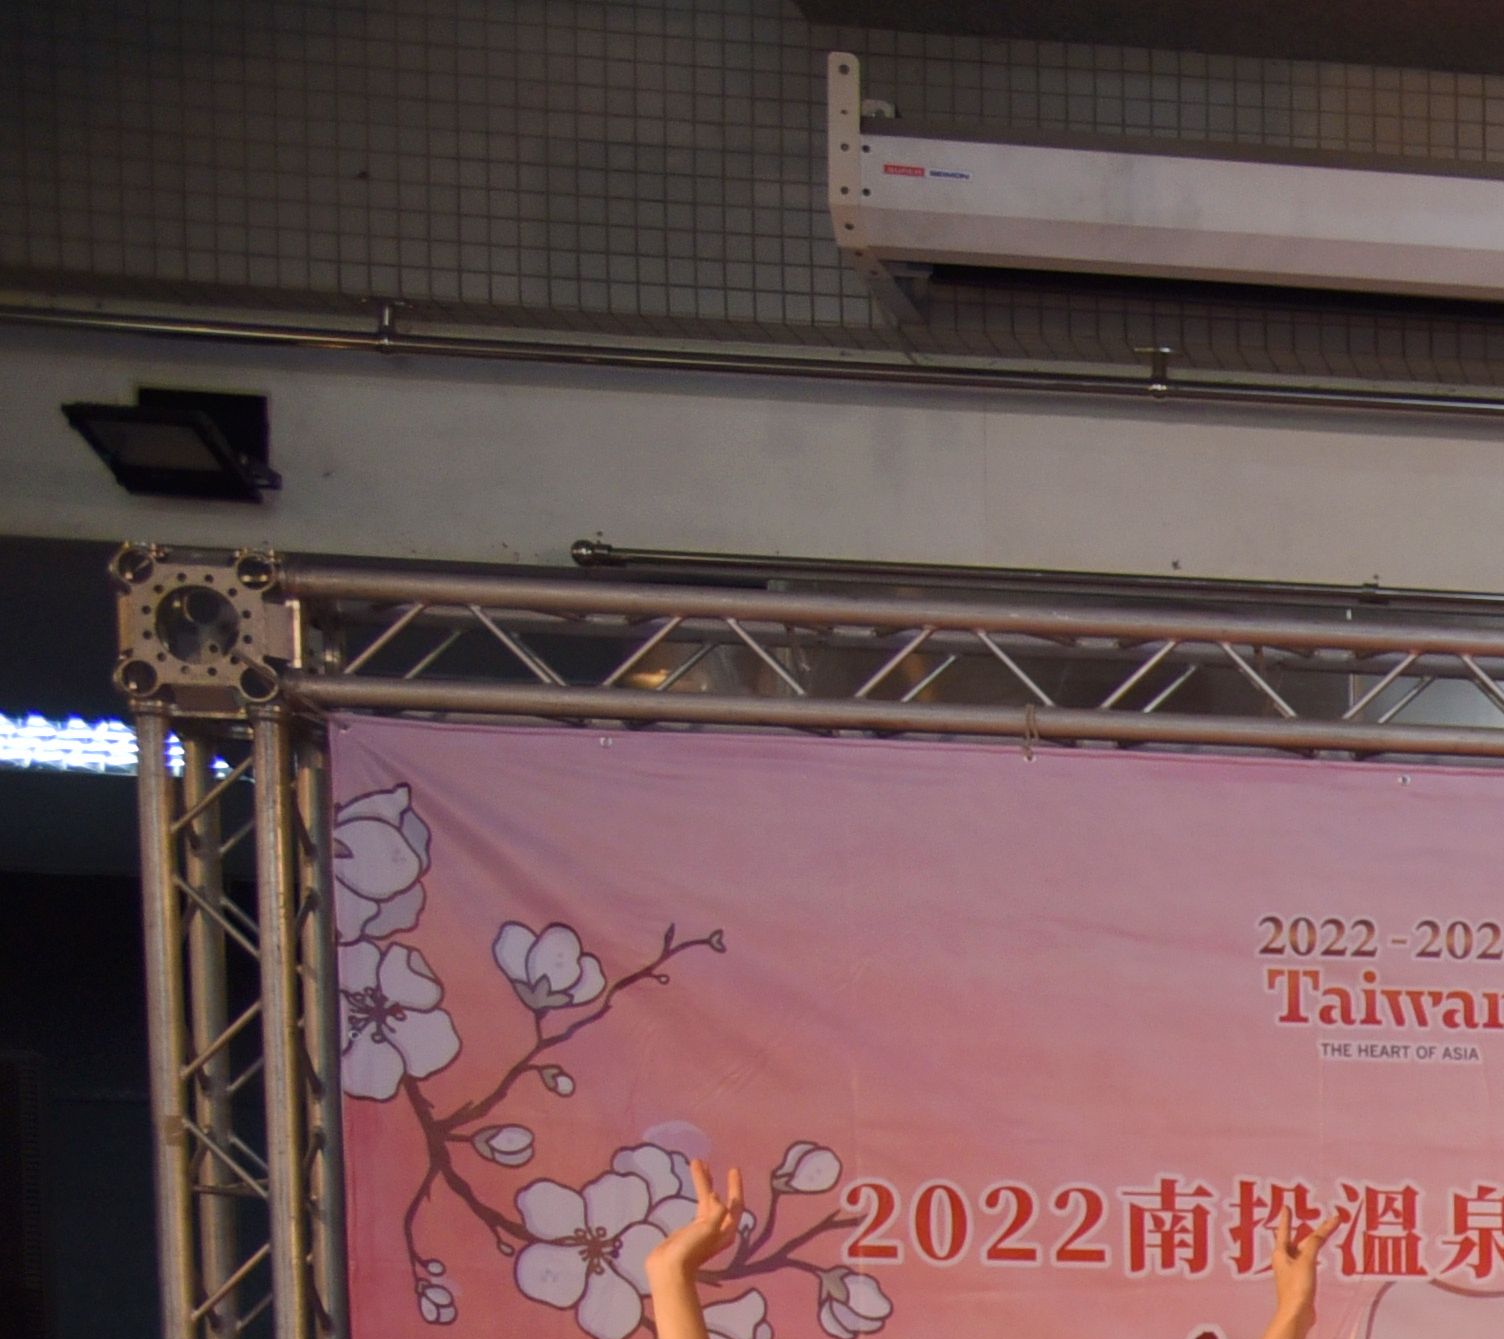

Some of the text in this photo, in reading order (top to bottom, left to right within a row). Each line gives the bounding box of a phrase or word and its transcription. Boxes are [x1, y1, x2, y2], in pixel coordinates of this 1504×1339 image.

[1320, 1043, 1480, 1062] THE HEART OF ASIA
